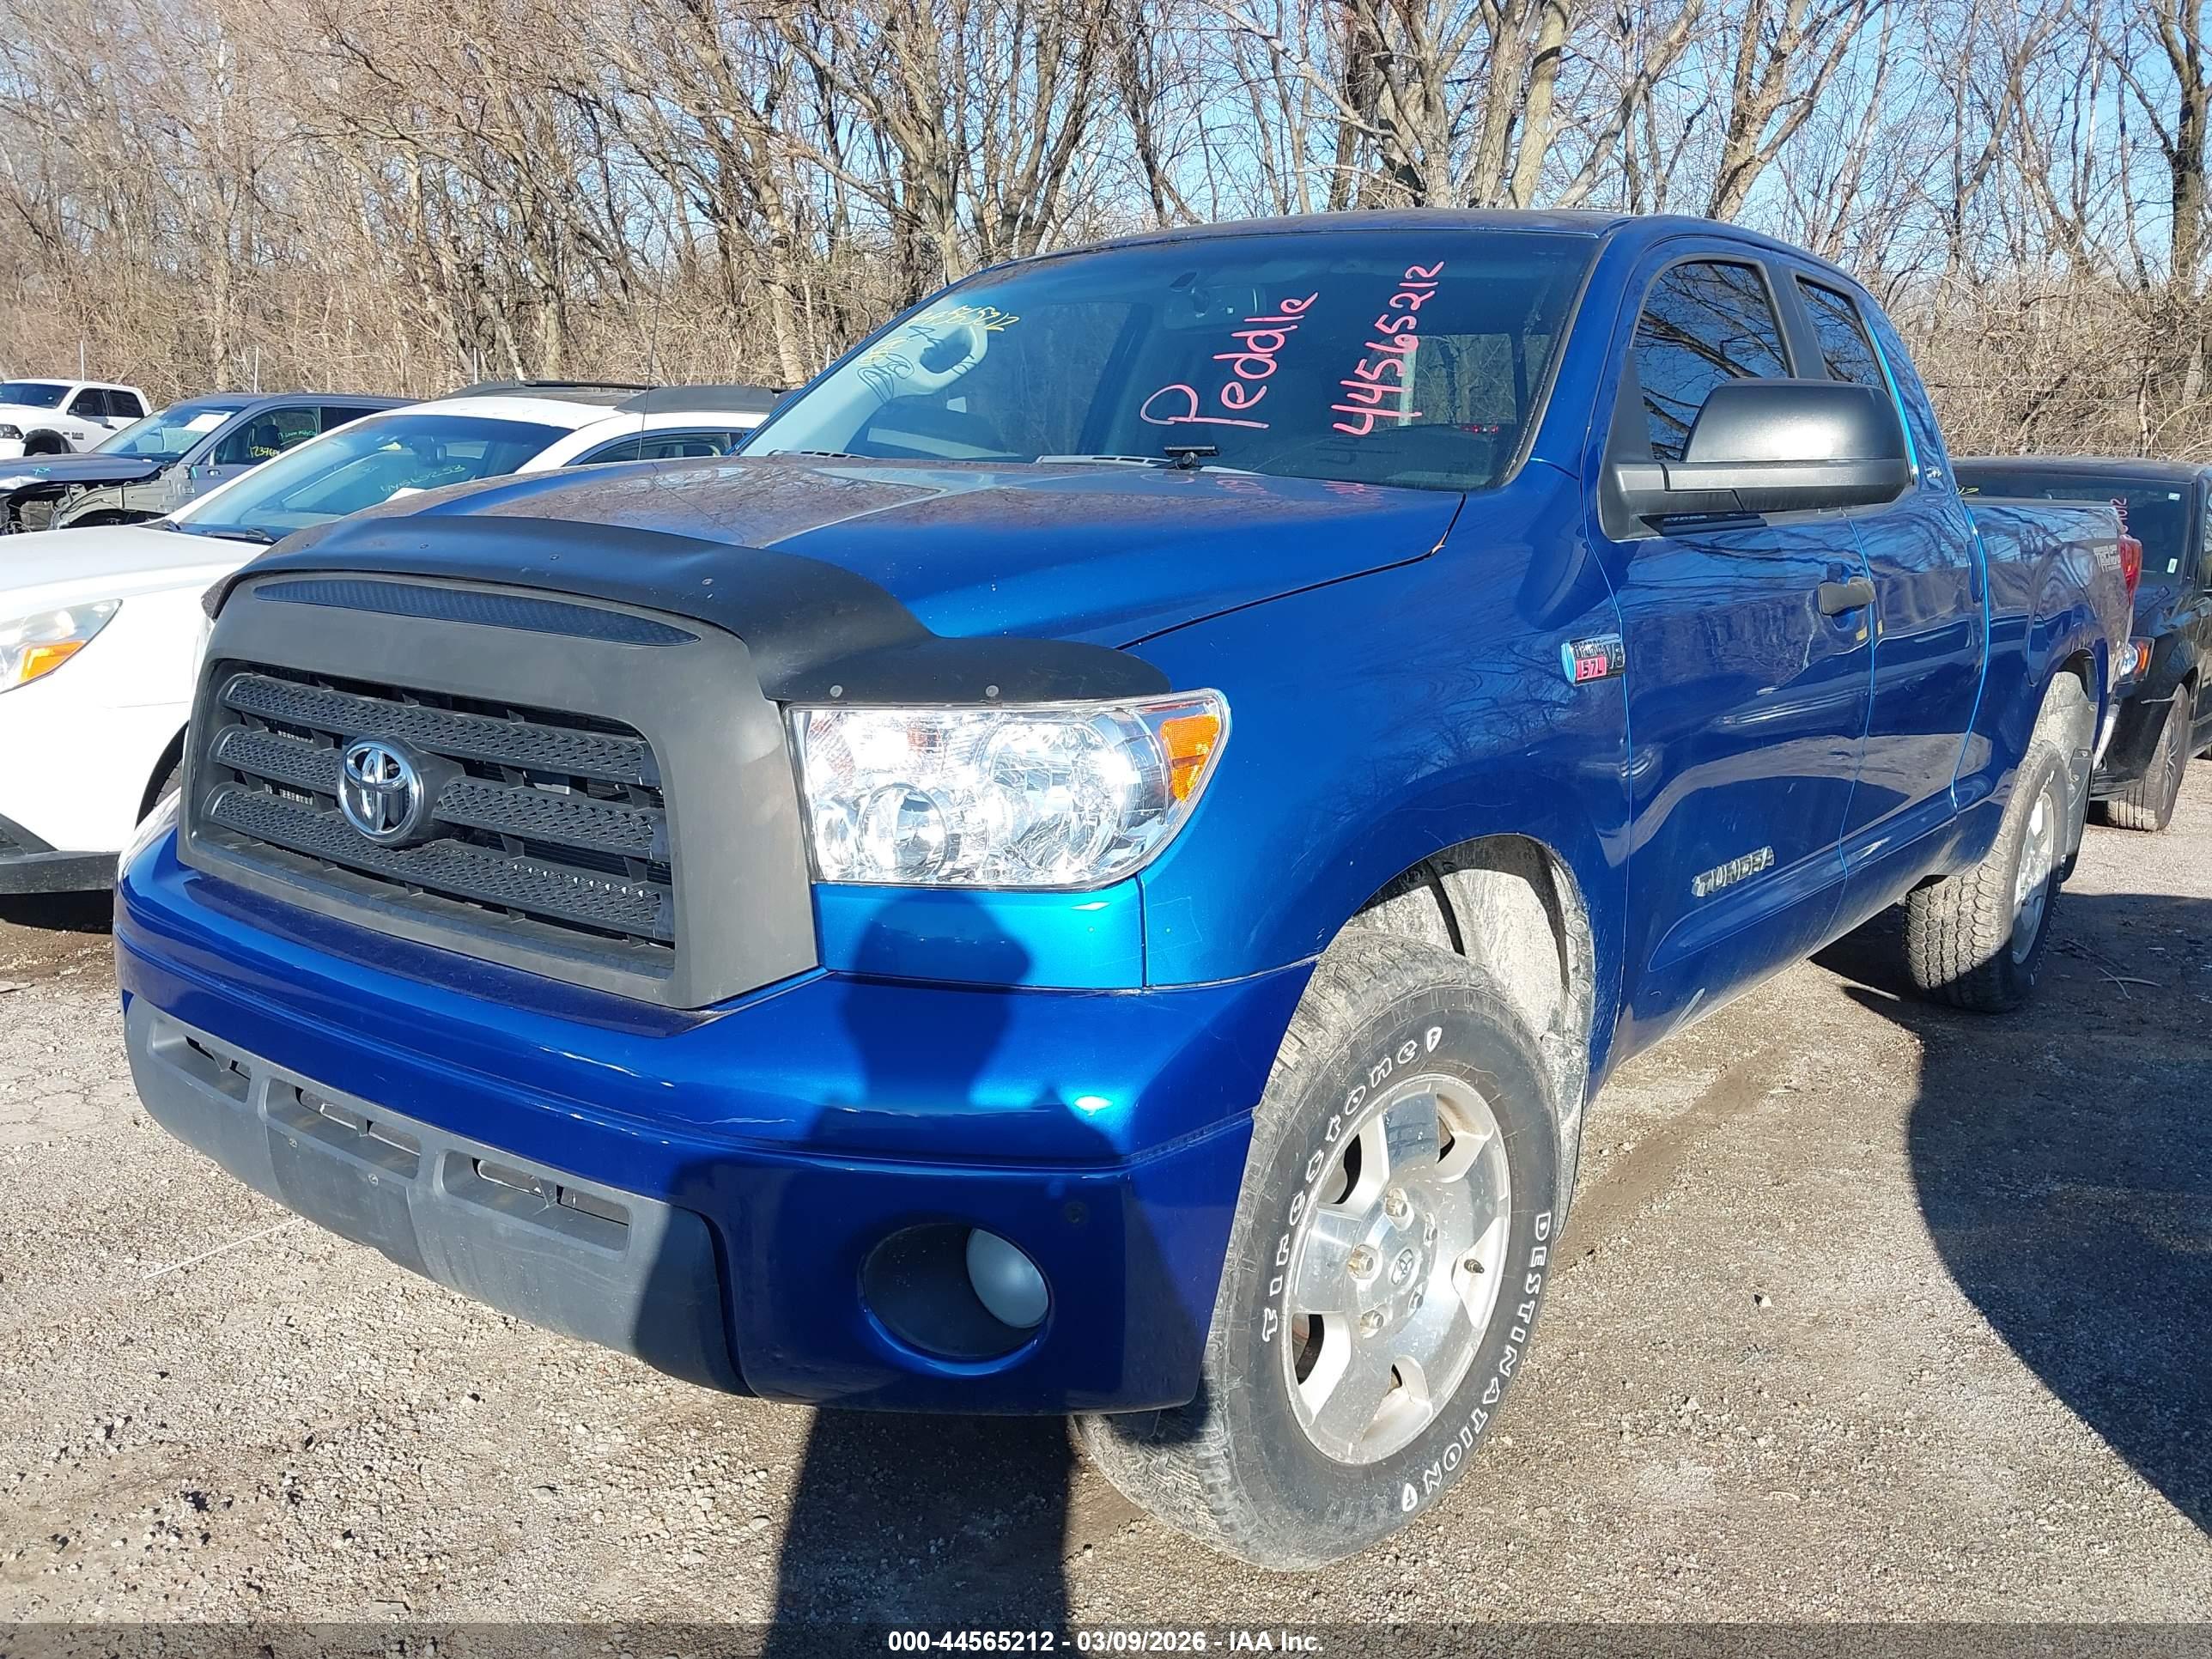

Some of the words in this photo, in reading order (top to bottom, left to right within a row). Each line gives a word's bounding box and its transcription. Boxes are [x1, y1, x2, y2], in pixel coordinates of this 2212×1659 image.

[1139, 291, 1319, 428] Peddle
[1331, 261, 1445, 435] 44565212
[1691, 846, 1775, 897] TUNDRA
[1424, 1212, 1552, 1496] DESTINATION
